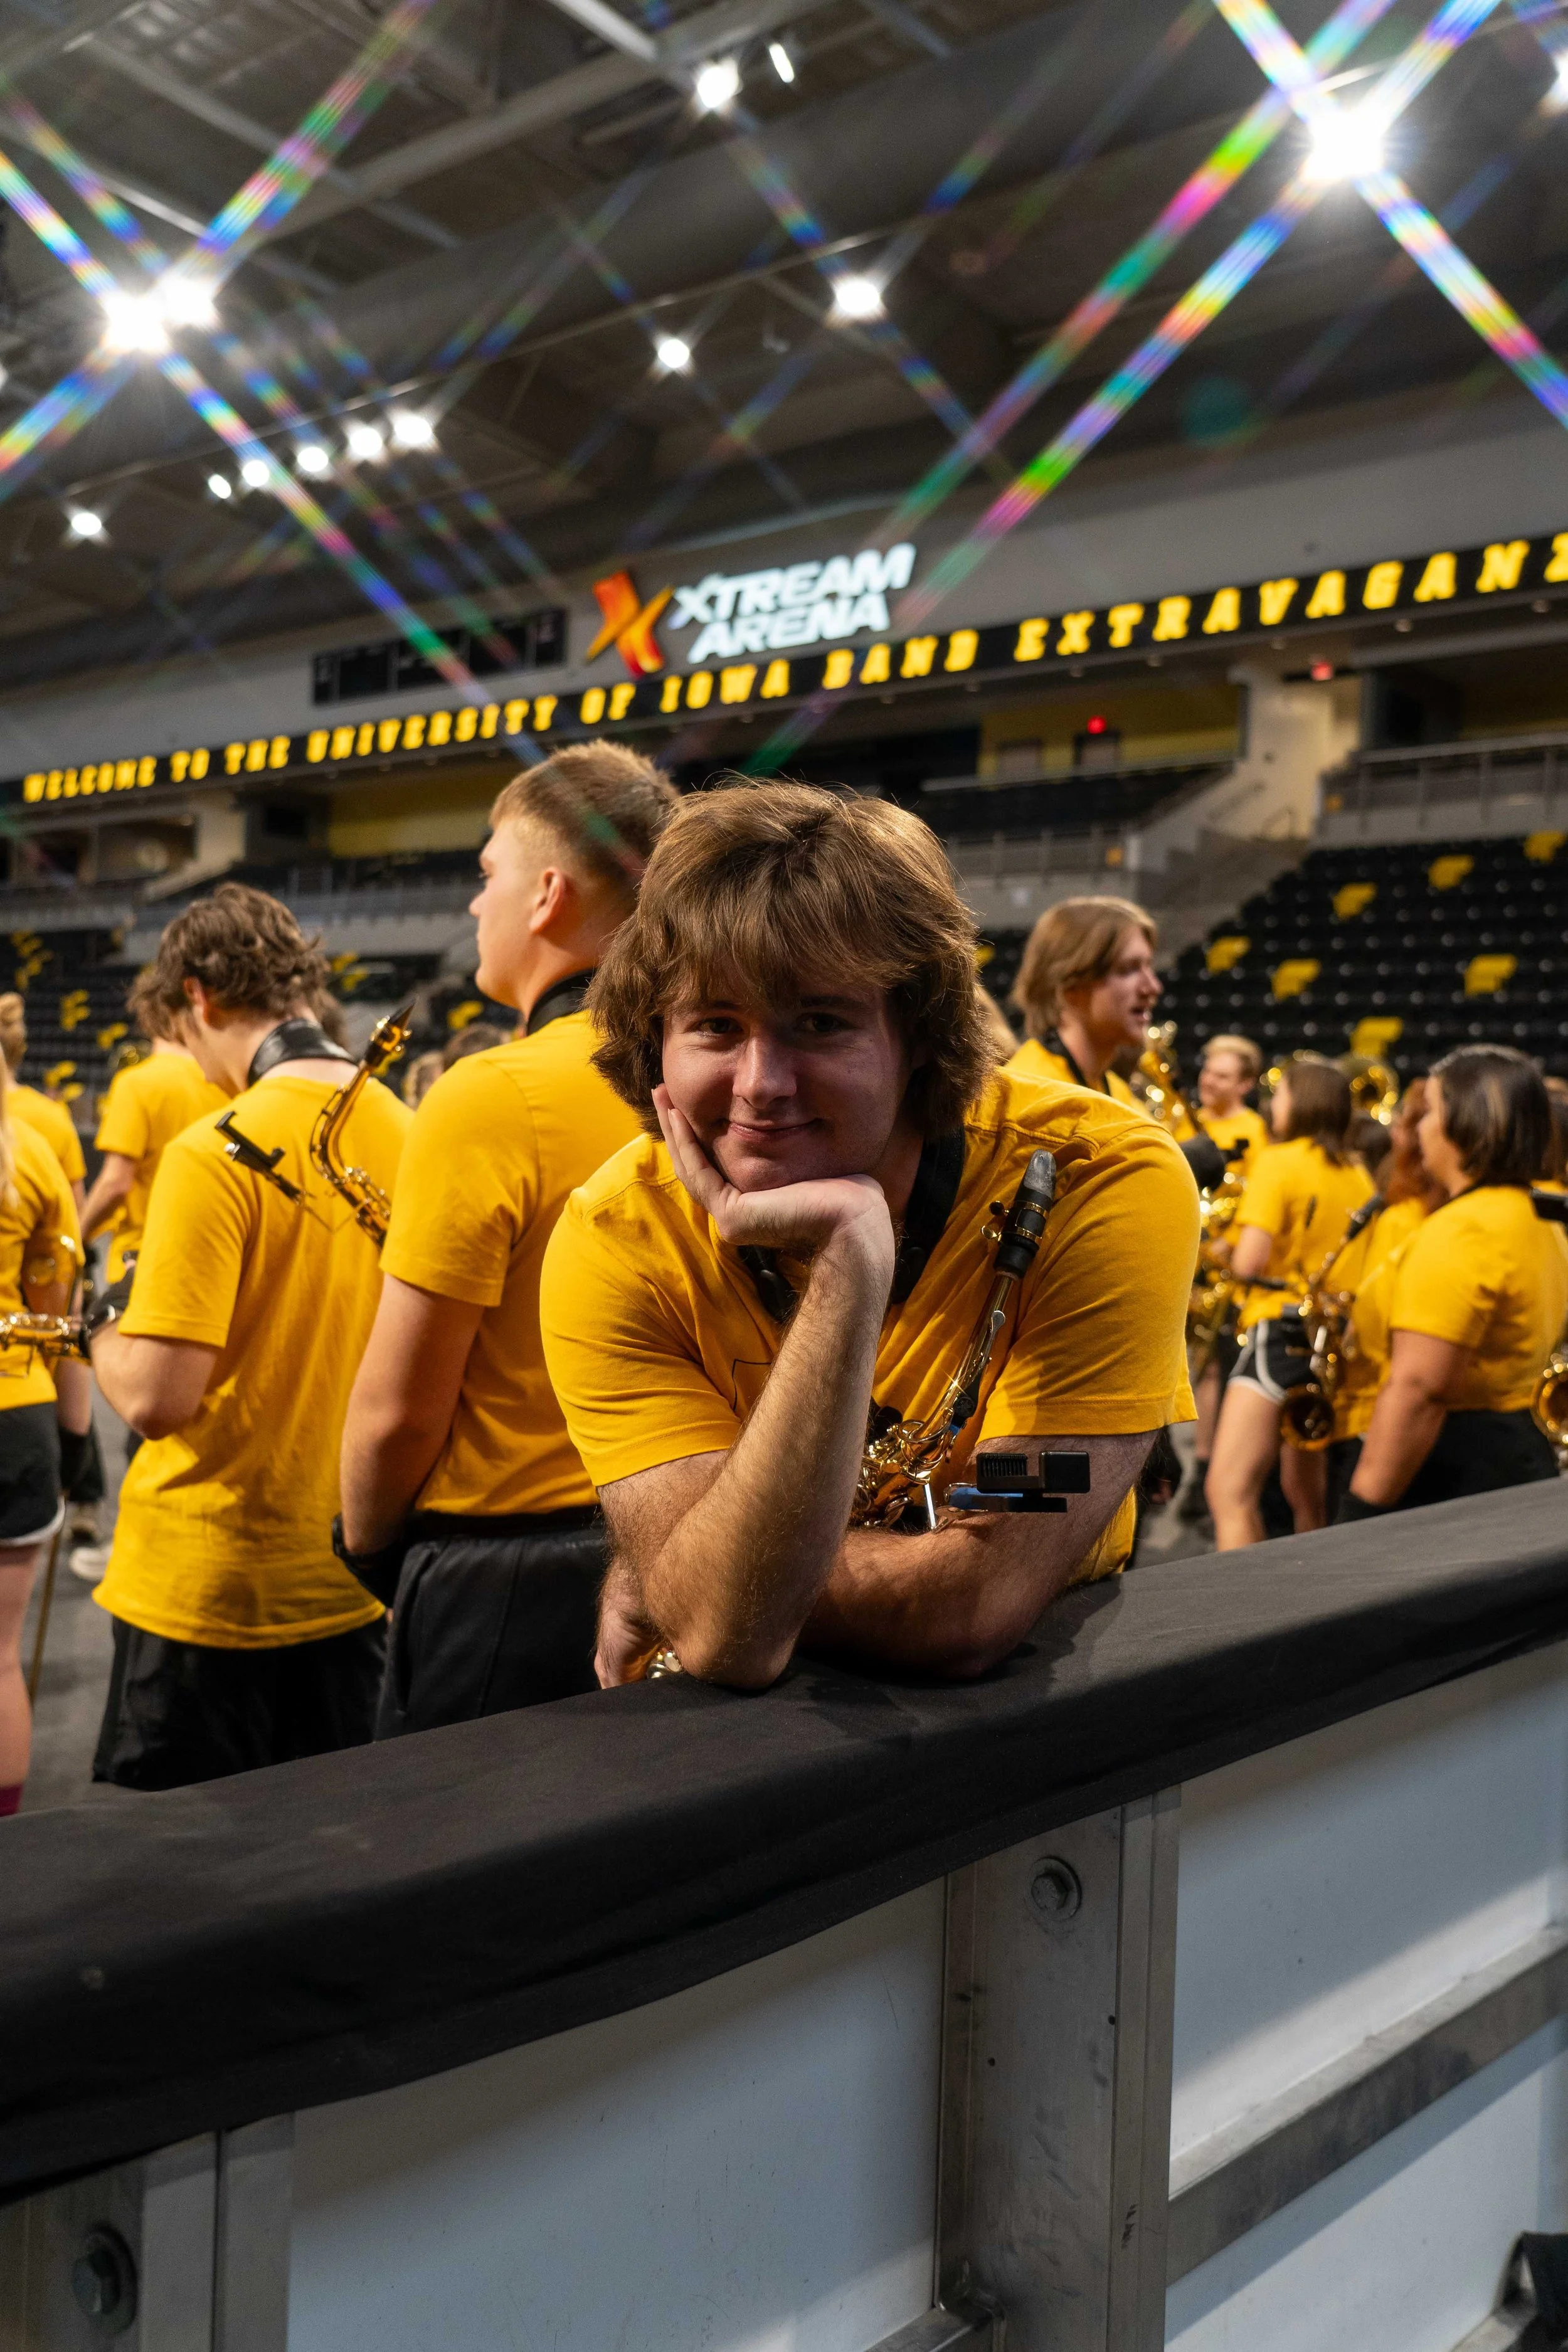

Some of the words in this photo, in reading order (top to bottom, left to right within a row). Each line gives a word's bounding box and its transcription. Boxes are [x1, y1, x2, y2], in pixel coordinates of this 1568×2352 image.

[669, 541, 916, 630] XTREAM
[687, 593, 891, 664] ARENA
[24, 756, 157, 803] WELCOME
[171, 748, 209, 783] TO
[225, 736, 290, 775] THE
[306, 694, 558, 763] UNIVERSITY
[580, 682, 635, 724] OF
[660, 659, 790, 713] IOWA
[822, 629, 978, 690] BAND
